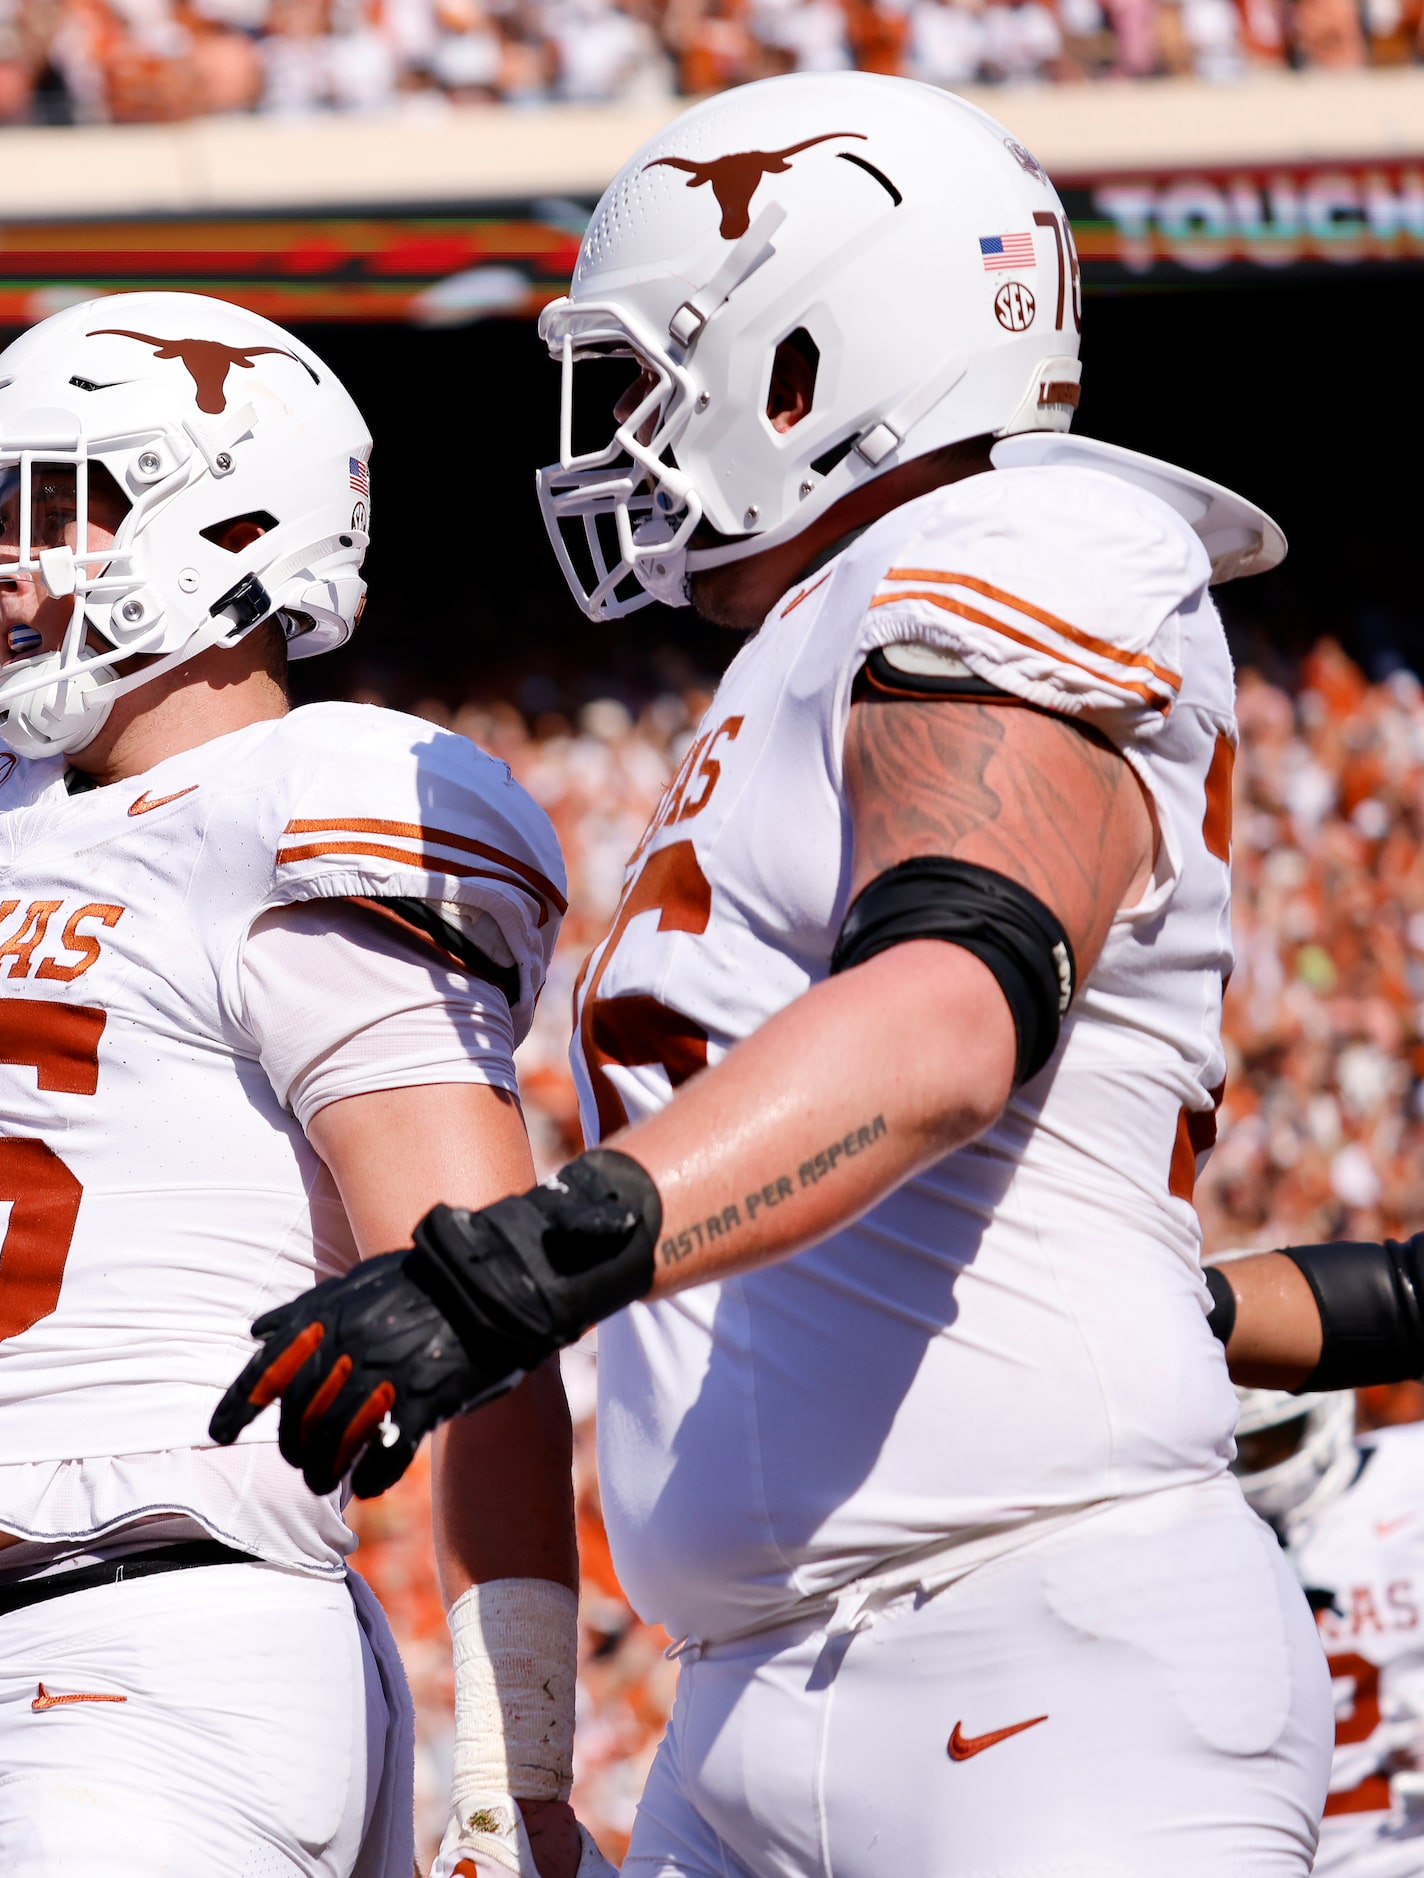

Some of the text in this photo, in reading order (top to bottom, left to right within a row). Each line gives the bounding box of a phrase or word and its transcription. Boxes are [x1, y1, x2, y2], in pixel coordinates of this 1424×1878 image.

[995, 282, 1035, 331] SEC
[661, 1113, 888, 1266] ASTRA PER ASPERA
